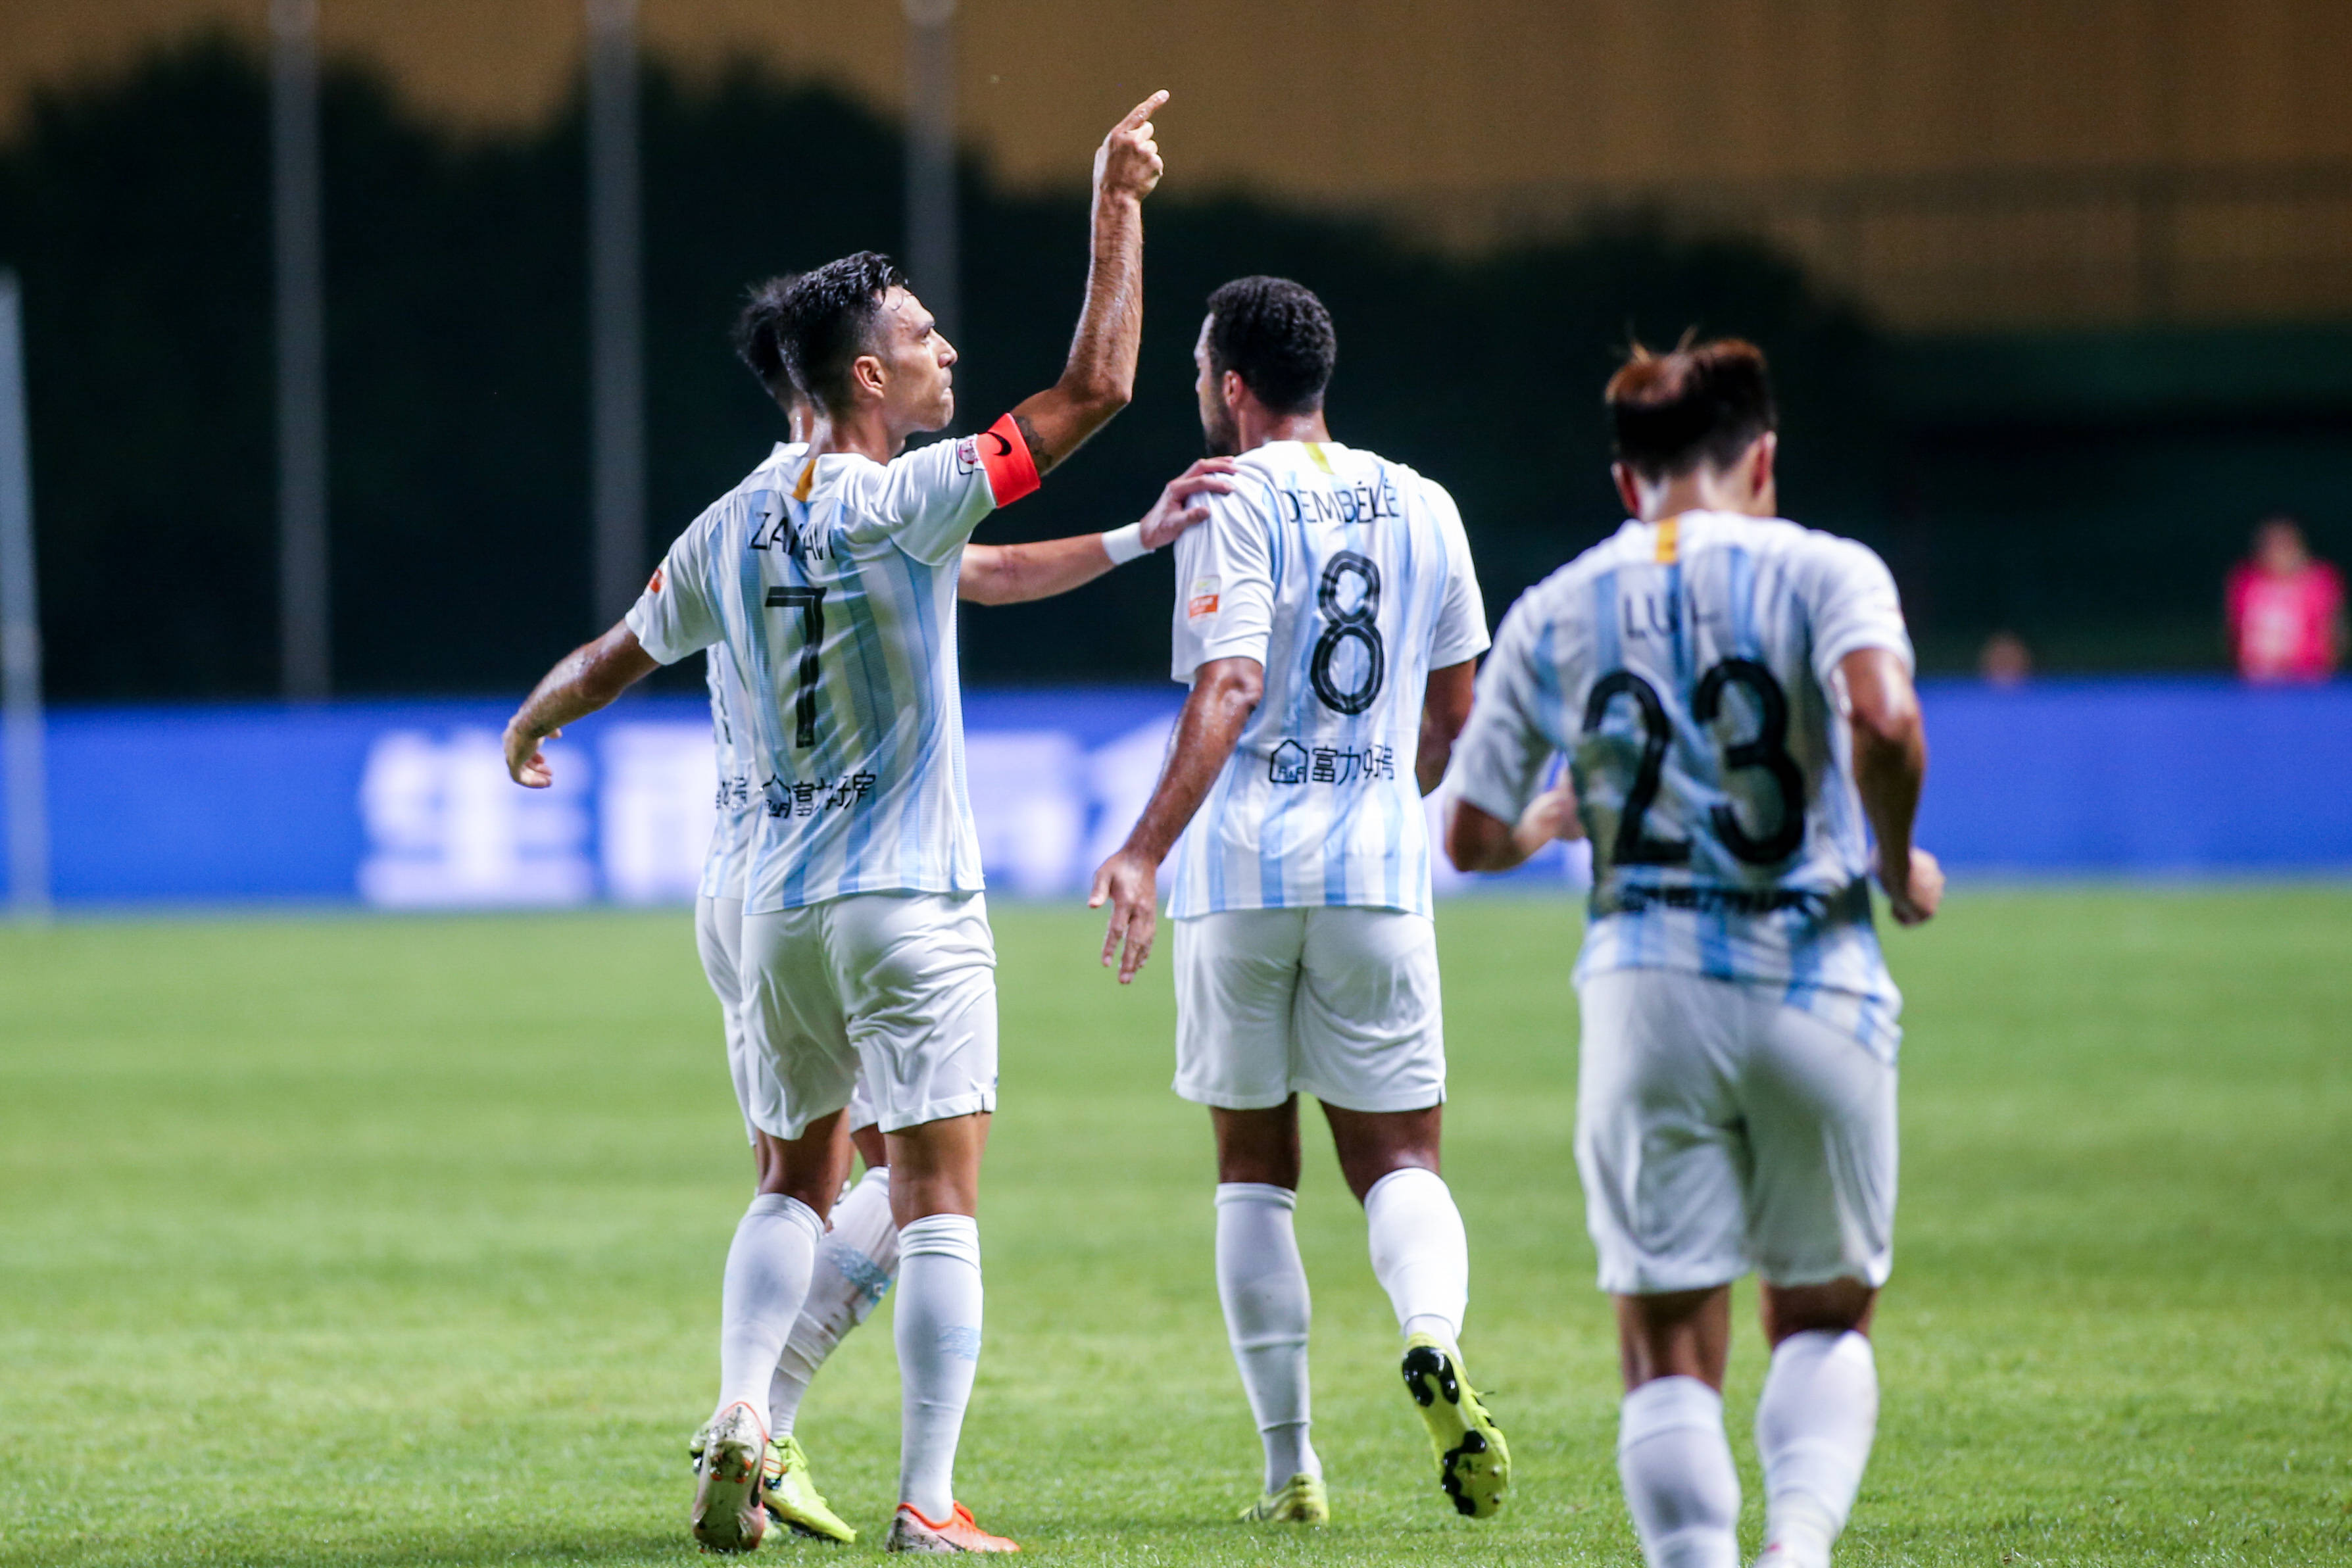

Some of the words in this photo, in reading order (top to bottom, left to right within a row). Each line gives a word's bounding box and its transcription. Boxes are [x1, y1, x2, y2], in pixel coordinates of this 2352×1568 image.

[765, 587, 827, 748] 7
[1310, 550, 1384, 715] 8
[1582, 658, 1806, 866] 23
